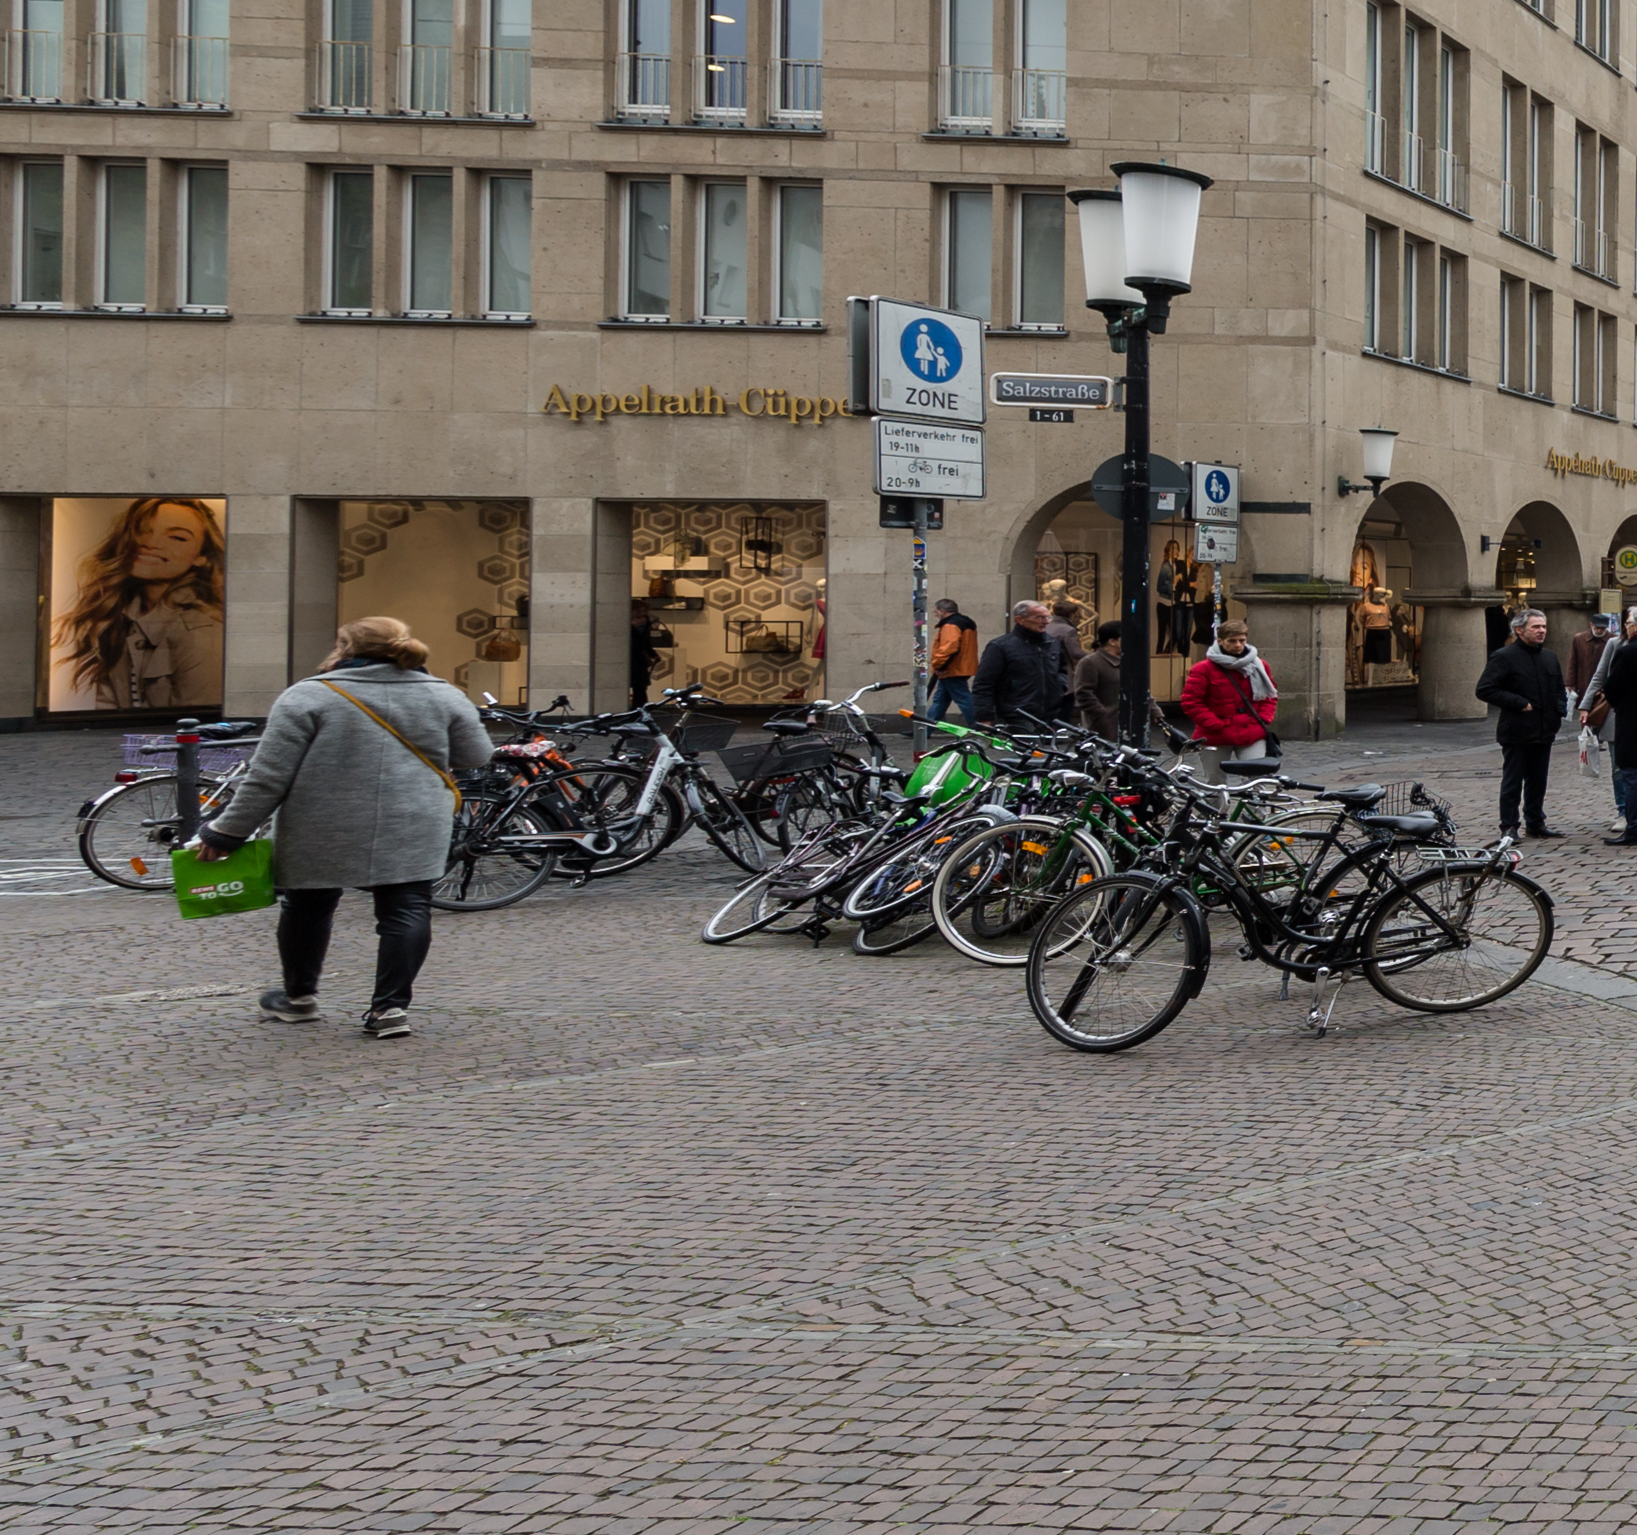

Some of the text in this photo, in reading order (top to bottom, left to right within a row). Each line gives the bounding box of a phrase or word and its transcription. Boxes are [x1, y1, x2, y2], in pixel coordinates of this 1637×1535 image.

[1002, 381, 1100, 400] Salzstraße
[539, 383, 852, 425] Appelrath-Cüppe
[906, 387, 959, 411] ZONE
[884, 425, 979, 445] Lieferverkehr frei
[889, 441, 920, 454] 19-11h
[937, 464, 959, 476] frei
[886, 477, 921, 488] 20-9h
[1206, 506, 1228, 517] ZONE
[217, 881, 244, 893] GO
[199, 892, 217, 900] TO
